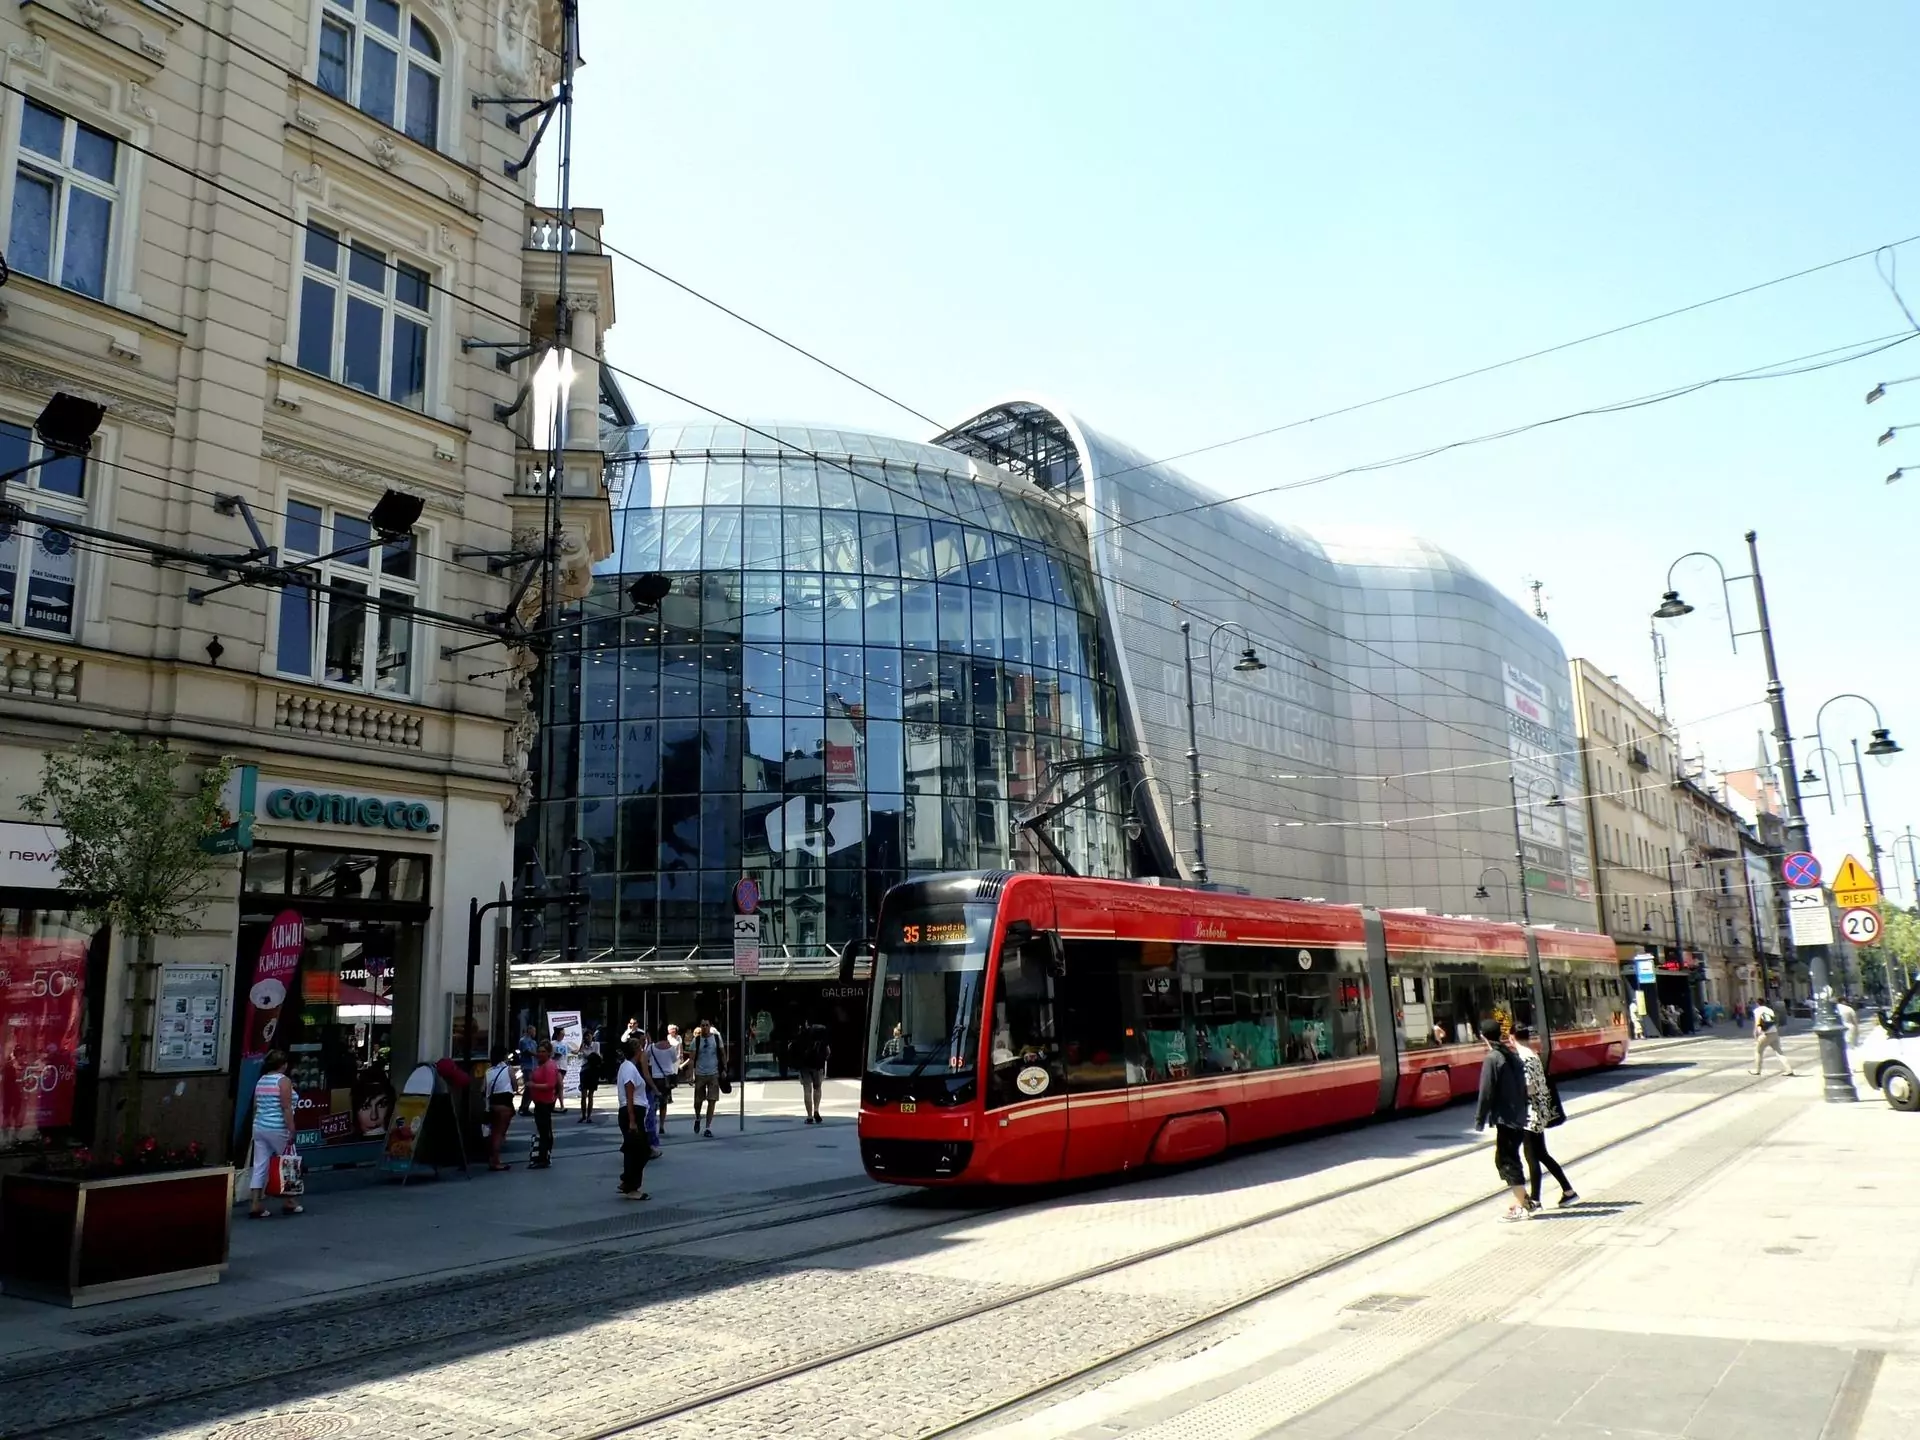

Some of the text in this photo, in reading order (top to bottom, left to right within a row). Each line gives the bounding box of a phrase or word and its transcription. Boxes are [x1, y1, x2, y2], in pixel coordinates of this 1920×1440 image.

[9, 850, 52, 862] new
[1843, 894, 1871, 904] PIESI
[926, 923, 965, 933] Zawodzie
[1847, 916, 1875, 935] 20
[271, 923, 302, 949] KAWA!
[903, 925, 920, 943] 35
[926, 931, 968, 942] Zajezdnia
[340, 967, 395, 980] STARBKS
[821, 987, 864, 998] GALERIA
